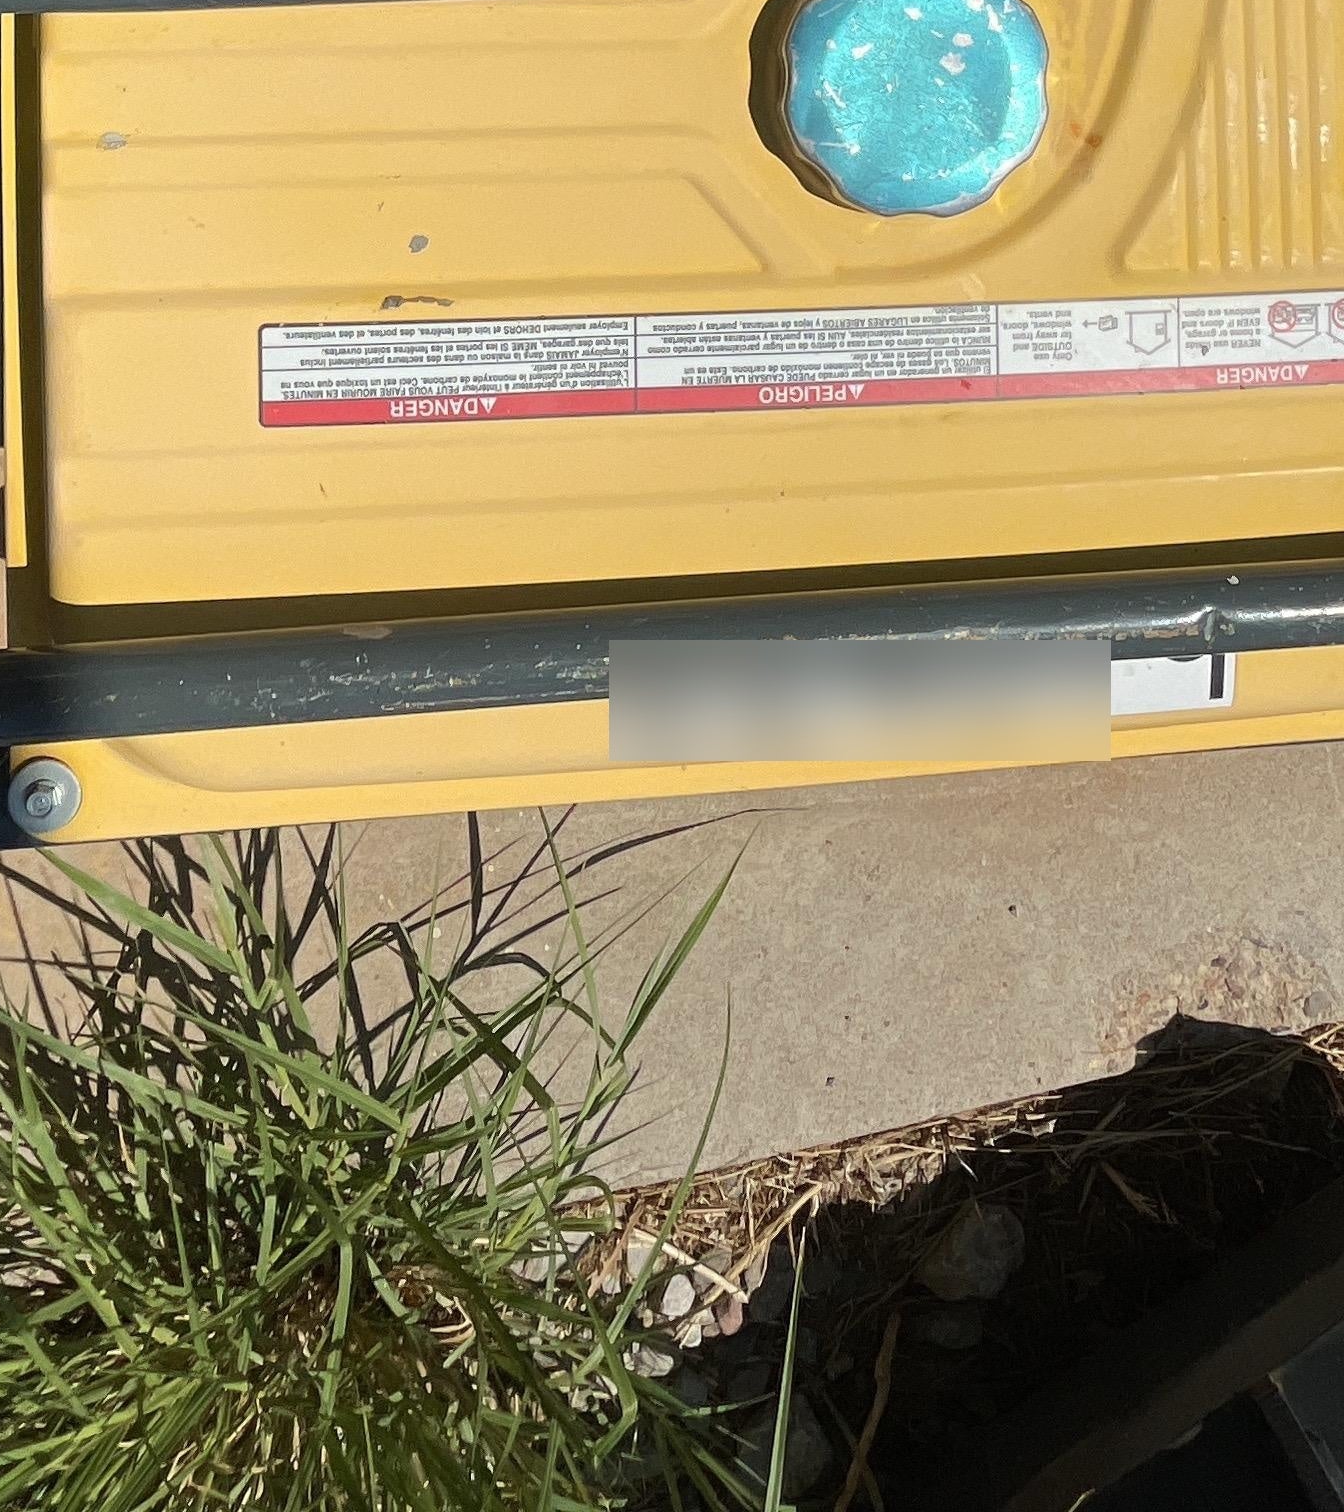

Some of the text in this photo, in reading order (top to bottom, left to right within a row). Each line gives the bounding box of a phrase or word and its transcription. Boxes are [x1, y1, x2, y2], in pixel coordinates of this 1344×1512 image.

[1216, 366, 1293, 385] DANGER
[759, 385, 846, 403] PELIGRO
[391, 398, 478, 417] DANGER
